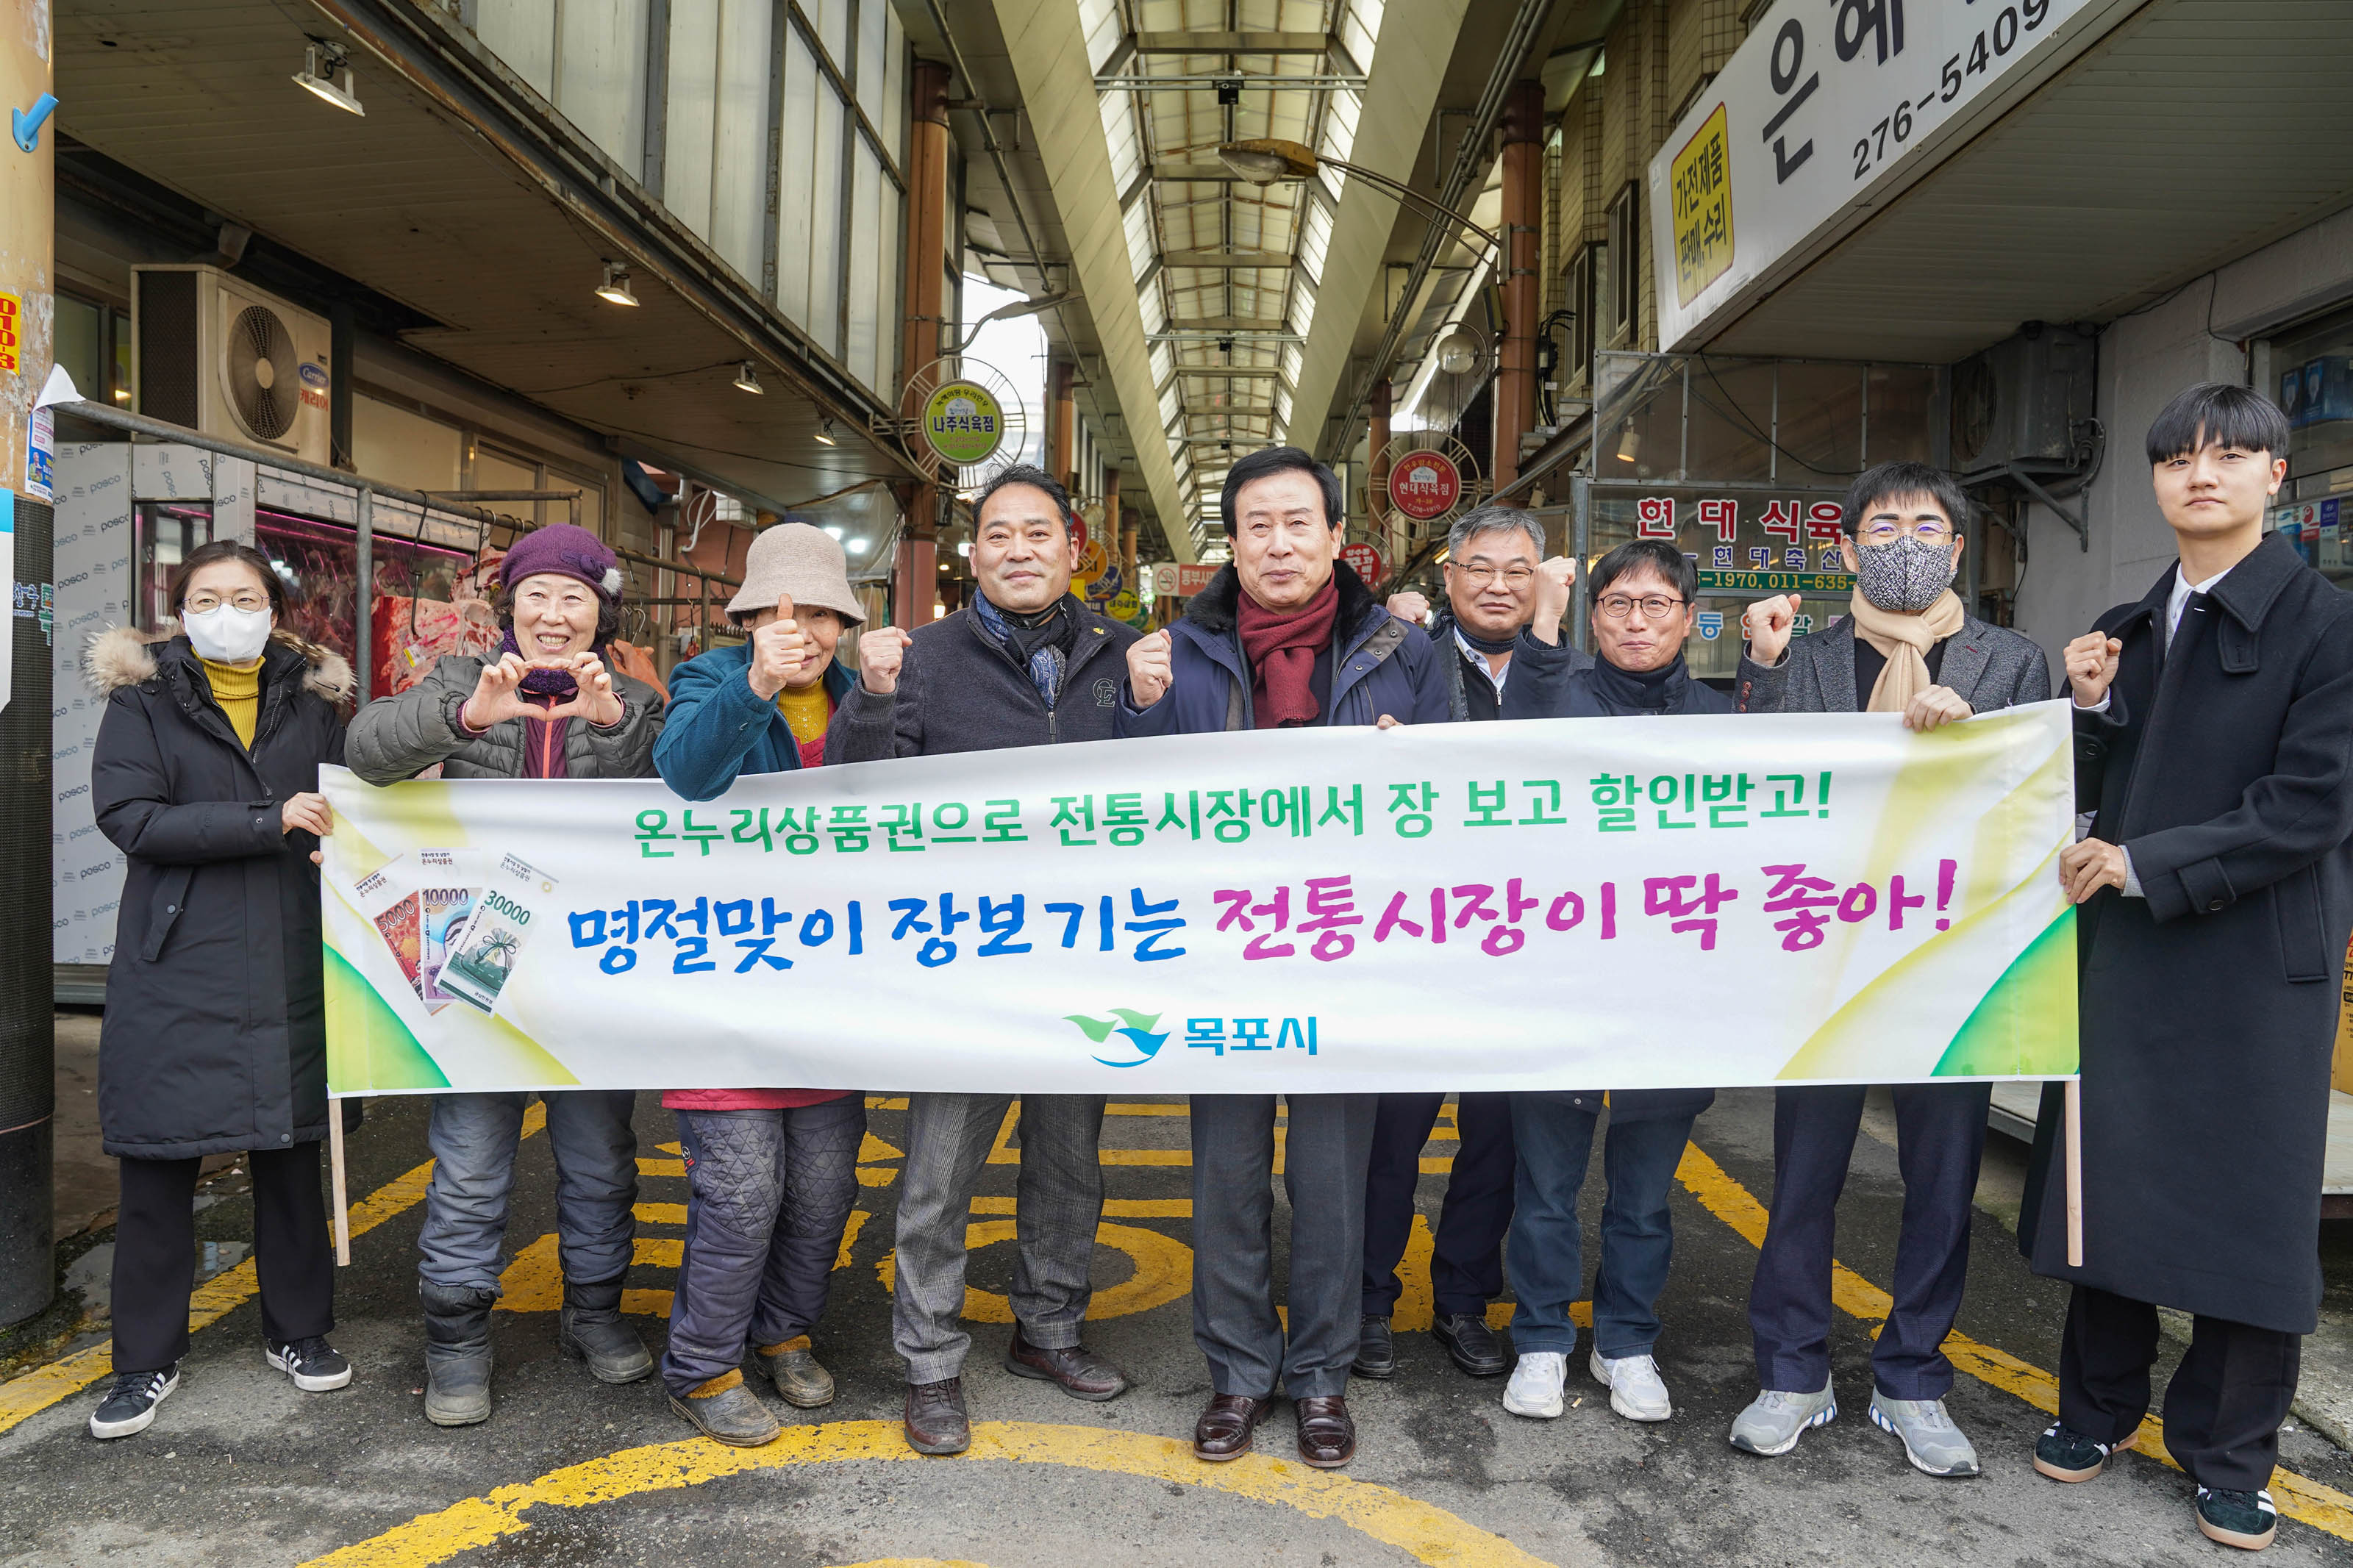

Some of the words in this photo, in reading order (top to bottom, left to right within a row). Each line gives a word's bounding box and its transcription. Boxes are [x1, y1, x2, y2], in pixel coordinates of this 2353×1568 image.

[1853, 0, 2049, 181] 276-5409
[1676, 131, 1723, 220] 가전제품
[302, 368, 326, 384] Carrier
[933, 415, 995, 434] 나주식육점
[79, 443, 104, 455] pos
[90, 474, 121, 494] posco
[1399, 482, 1449, 496] 현대식육점
[53, 533, 78, 548] osco
[57, 572, 89, 591] posco
[1697, 572, 1763, 589] -1970,
[68, 611, 99, 629] posco
[53, 745, 79, 760] osco
[58, 784, 89, 803] posco
[635, 799, 1029, 858] 온누리상품권으로
[1050, 784, 1363, 847] 전통시장에서
[1388, 781, 1440, 838] 장
[1463, 779, 1567, 827] 보고
[1590, 771, 1832, 832] 할인받고!
[80, 861, 111, 880] posco
[421, 888, 469, 906] 10000
[376, 898, 415, 933] 5000
[484, 889, 531, 926] 30000
[568, 896, 863, 975] 명절맞이
[888, 887, 1187, 968] 장보기는
[1213, 875, 1616, 962] 전통시장이
[1643, 873, 1738, 951] 딱
[1761, 859, 1957, 952] 좋아!
[1185, 1016, 1318, 1056] 목포시
